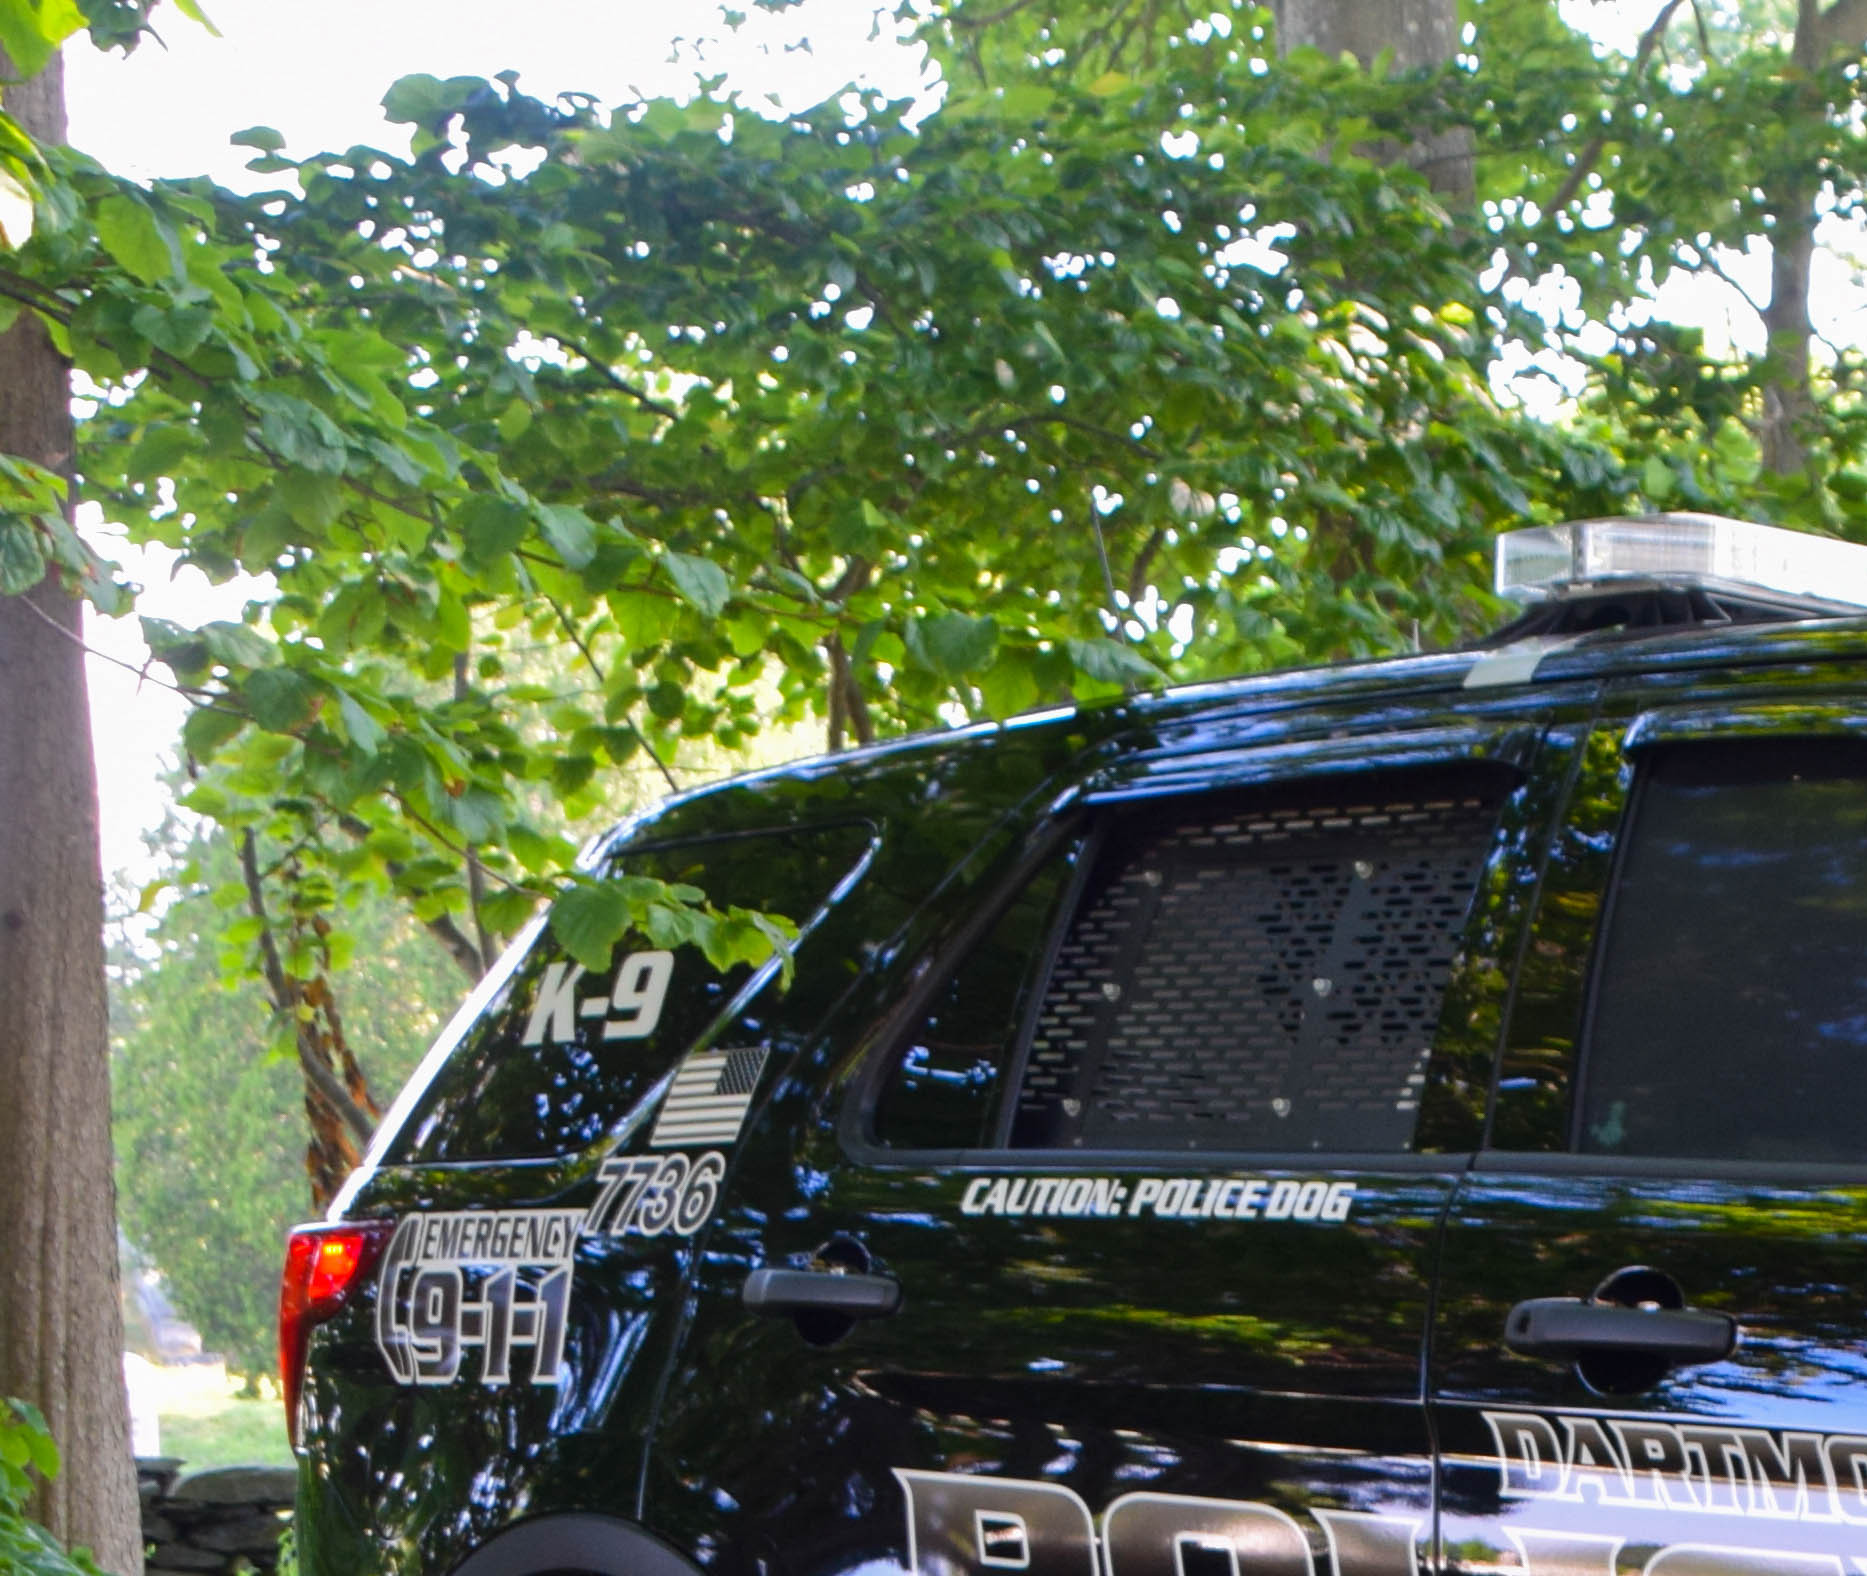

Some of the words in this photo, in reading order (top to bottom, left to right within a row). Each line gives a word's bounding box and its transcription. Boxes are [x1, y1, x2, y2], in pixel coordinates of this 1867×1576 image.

[521, 950, 674, 1046] K-9
[582, 1151, 726, 1237] 7736
[961, 1177, 1127, 1216] CAUTION:
[1128, 1177, 1267, 1219] POLICE
[1265, 1181, 1357, 1222] DOG
[424, 1213, 580, 1259] EMERGENCY
